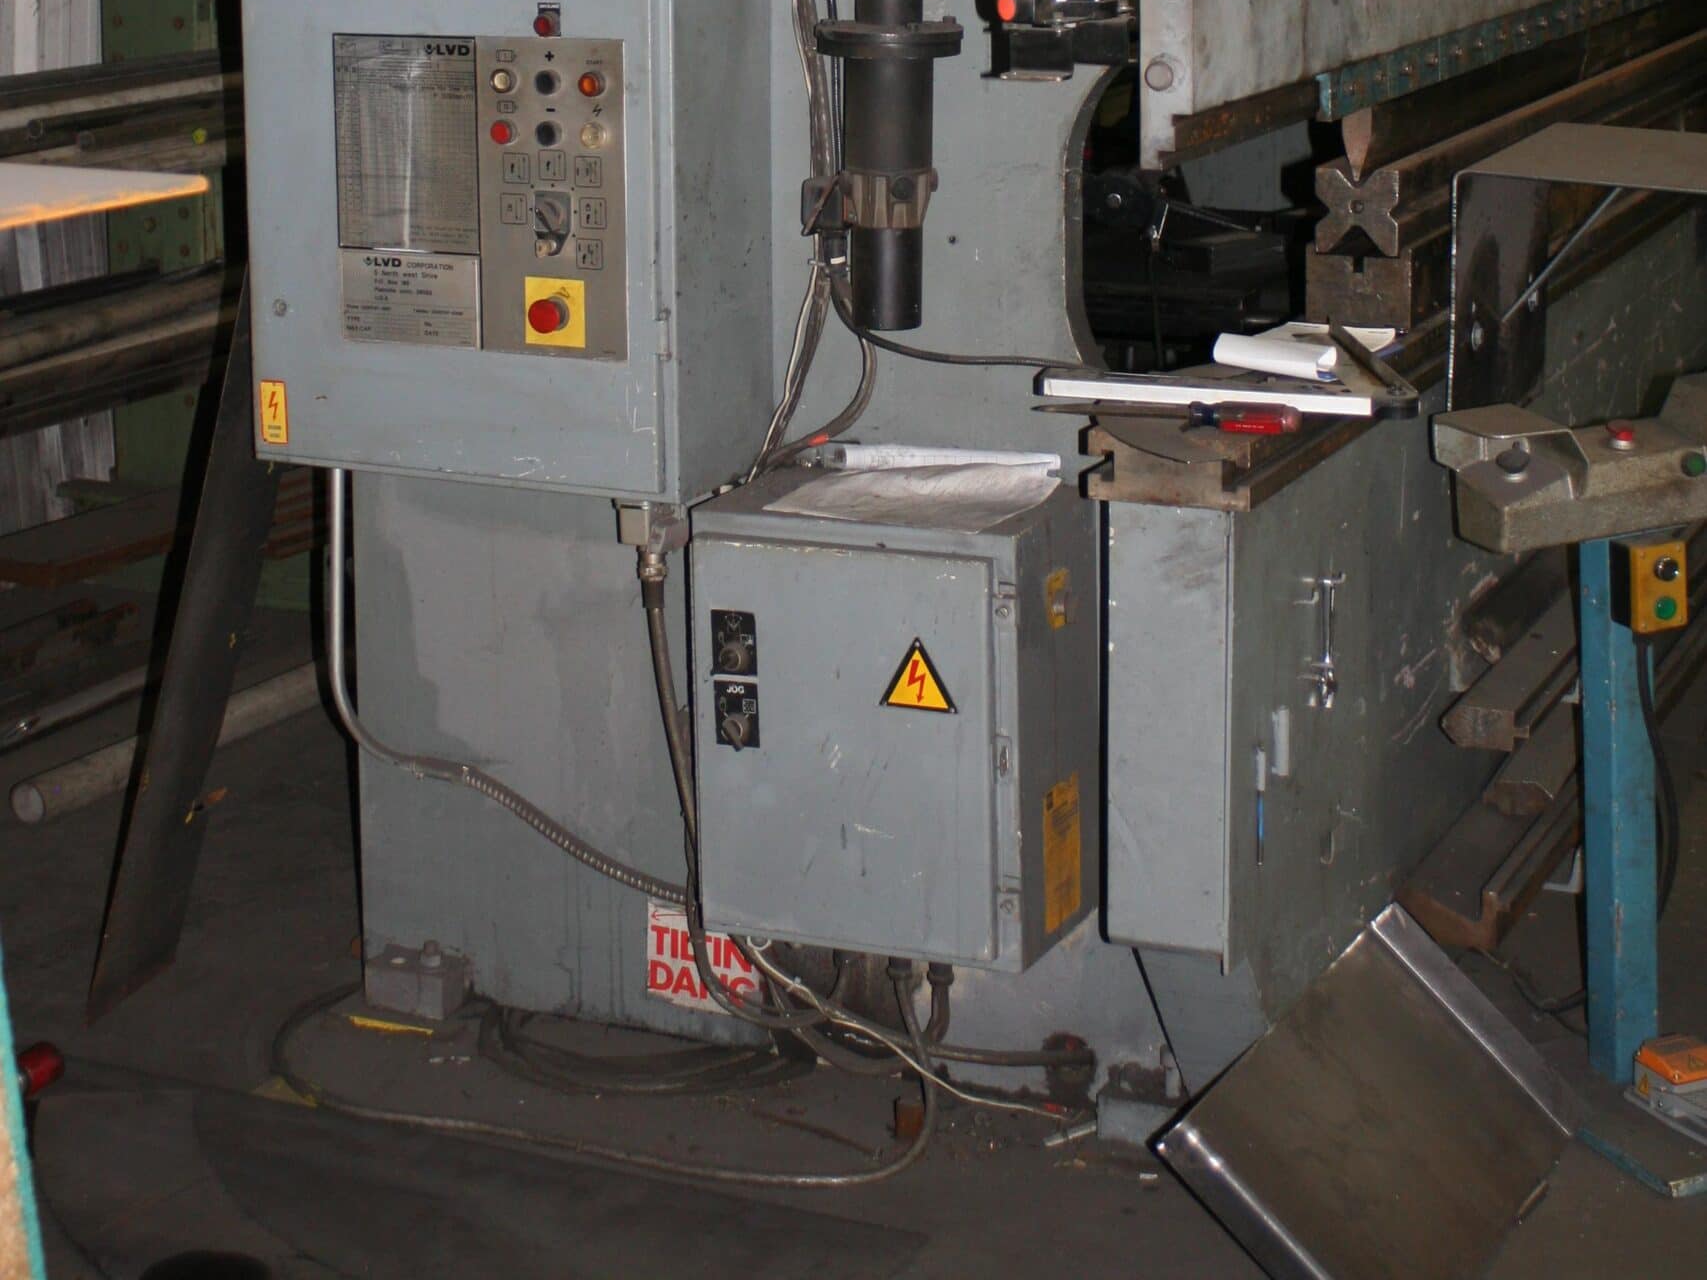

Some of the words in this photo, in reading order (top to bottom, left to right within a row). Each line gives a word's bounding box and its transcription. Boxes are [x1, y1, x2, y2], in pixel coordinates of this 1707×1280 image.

[437, 44, 470, 56] LVD
[374, 257, 402, 268] LVD
[407, 262, 454, 271] CORPORATION
[726, 685, 744, 694] JOG
[650, 925, 752, 973] TILIN
